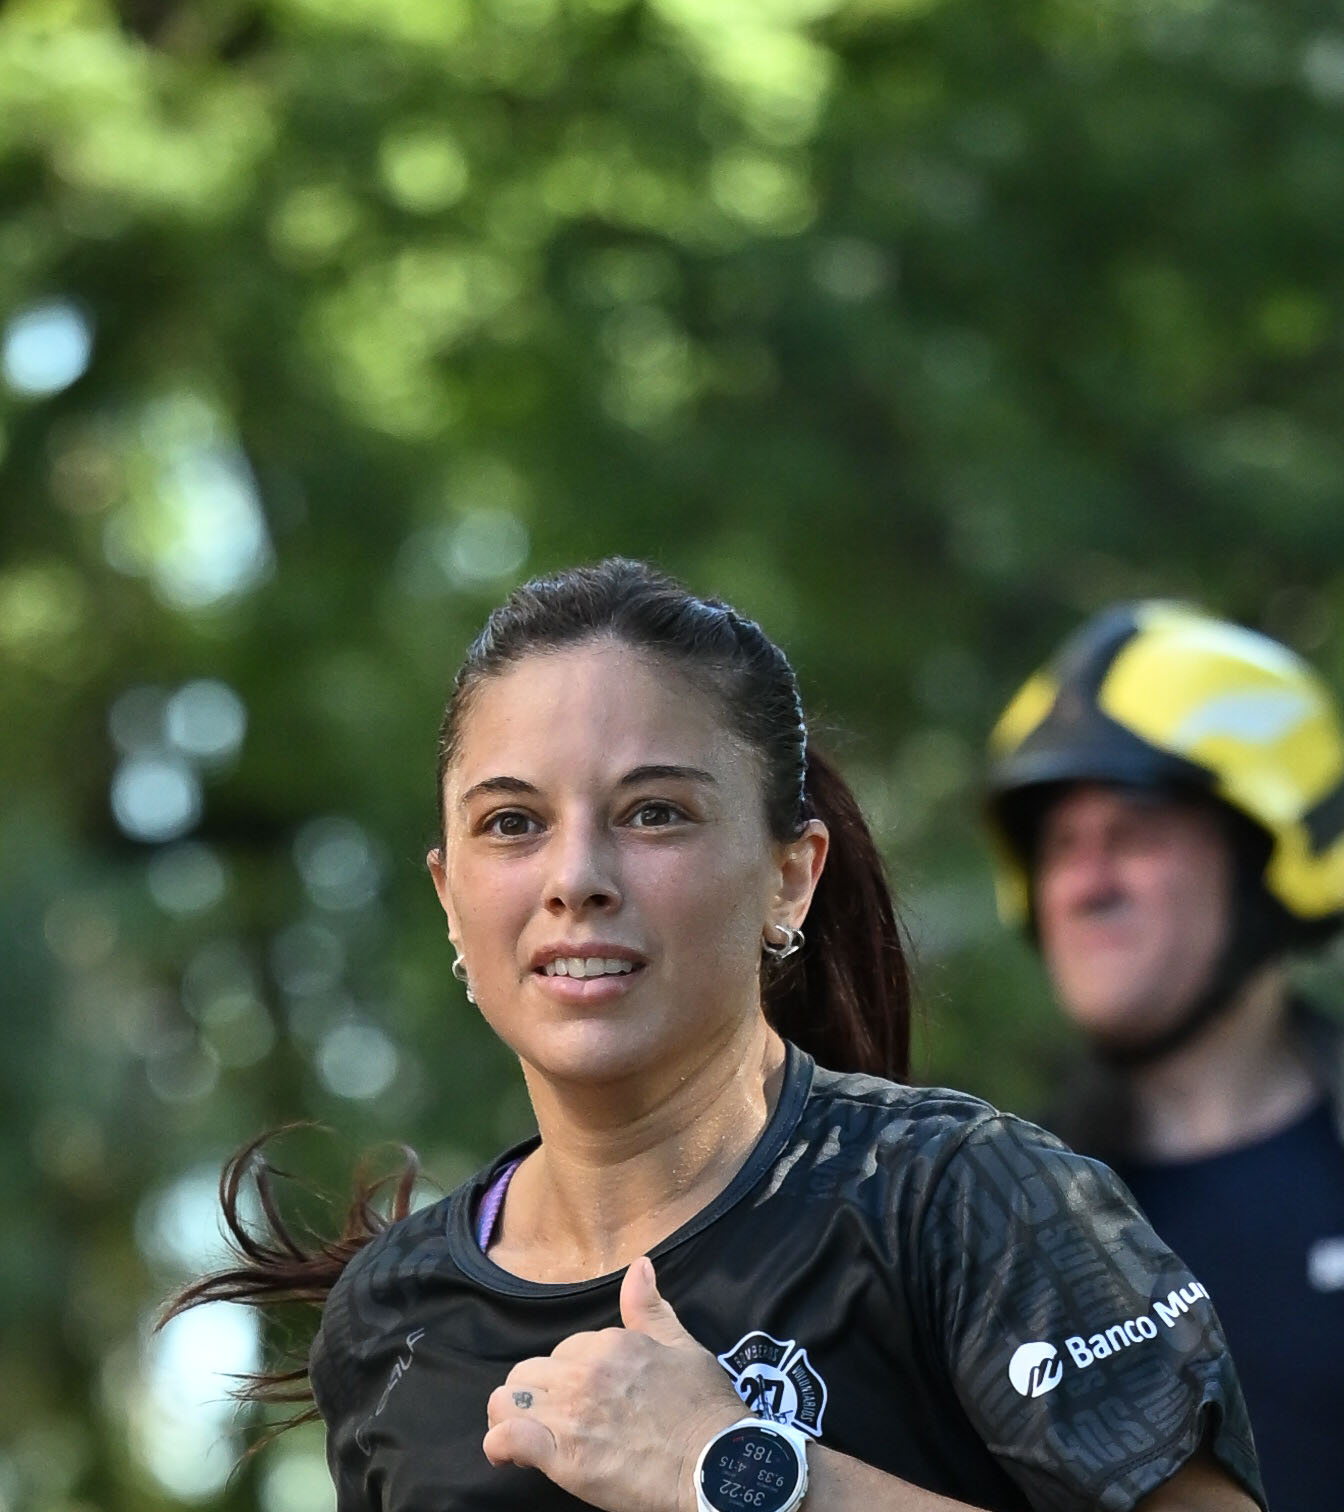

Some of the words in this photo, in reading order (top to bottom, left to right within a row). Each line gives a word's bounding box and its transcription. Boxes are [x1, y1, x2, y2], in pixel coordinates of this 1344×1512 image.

[733, 1344, 780, 1368] BOMBEROS
[1064, 1316, 1158, 1368] Banco
[740, 1376, 785, 1415] 27
[791, 1364, 817, 1422] VOLUNTARIOS
[719, 1456, 747, 1473] 4:15
[743, 1442, 773, 1463] 185
[719, 1479, 766, 1507] 39:22
